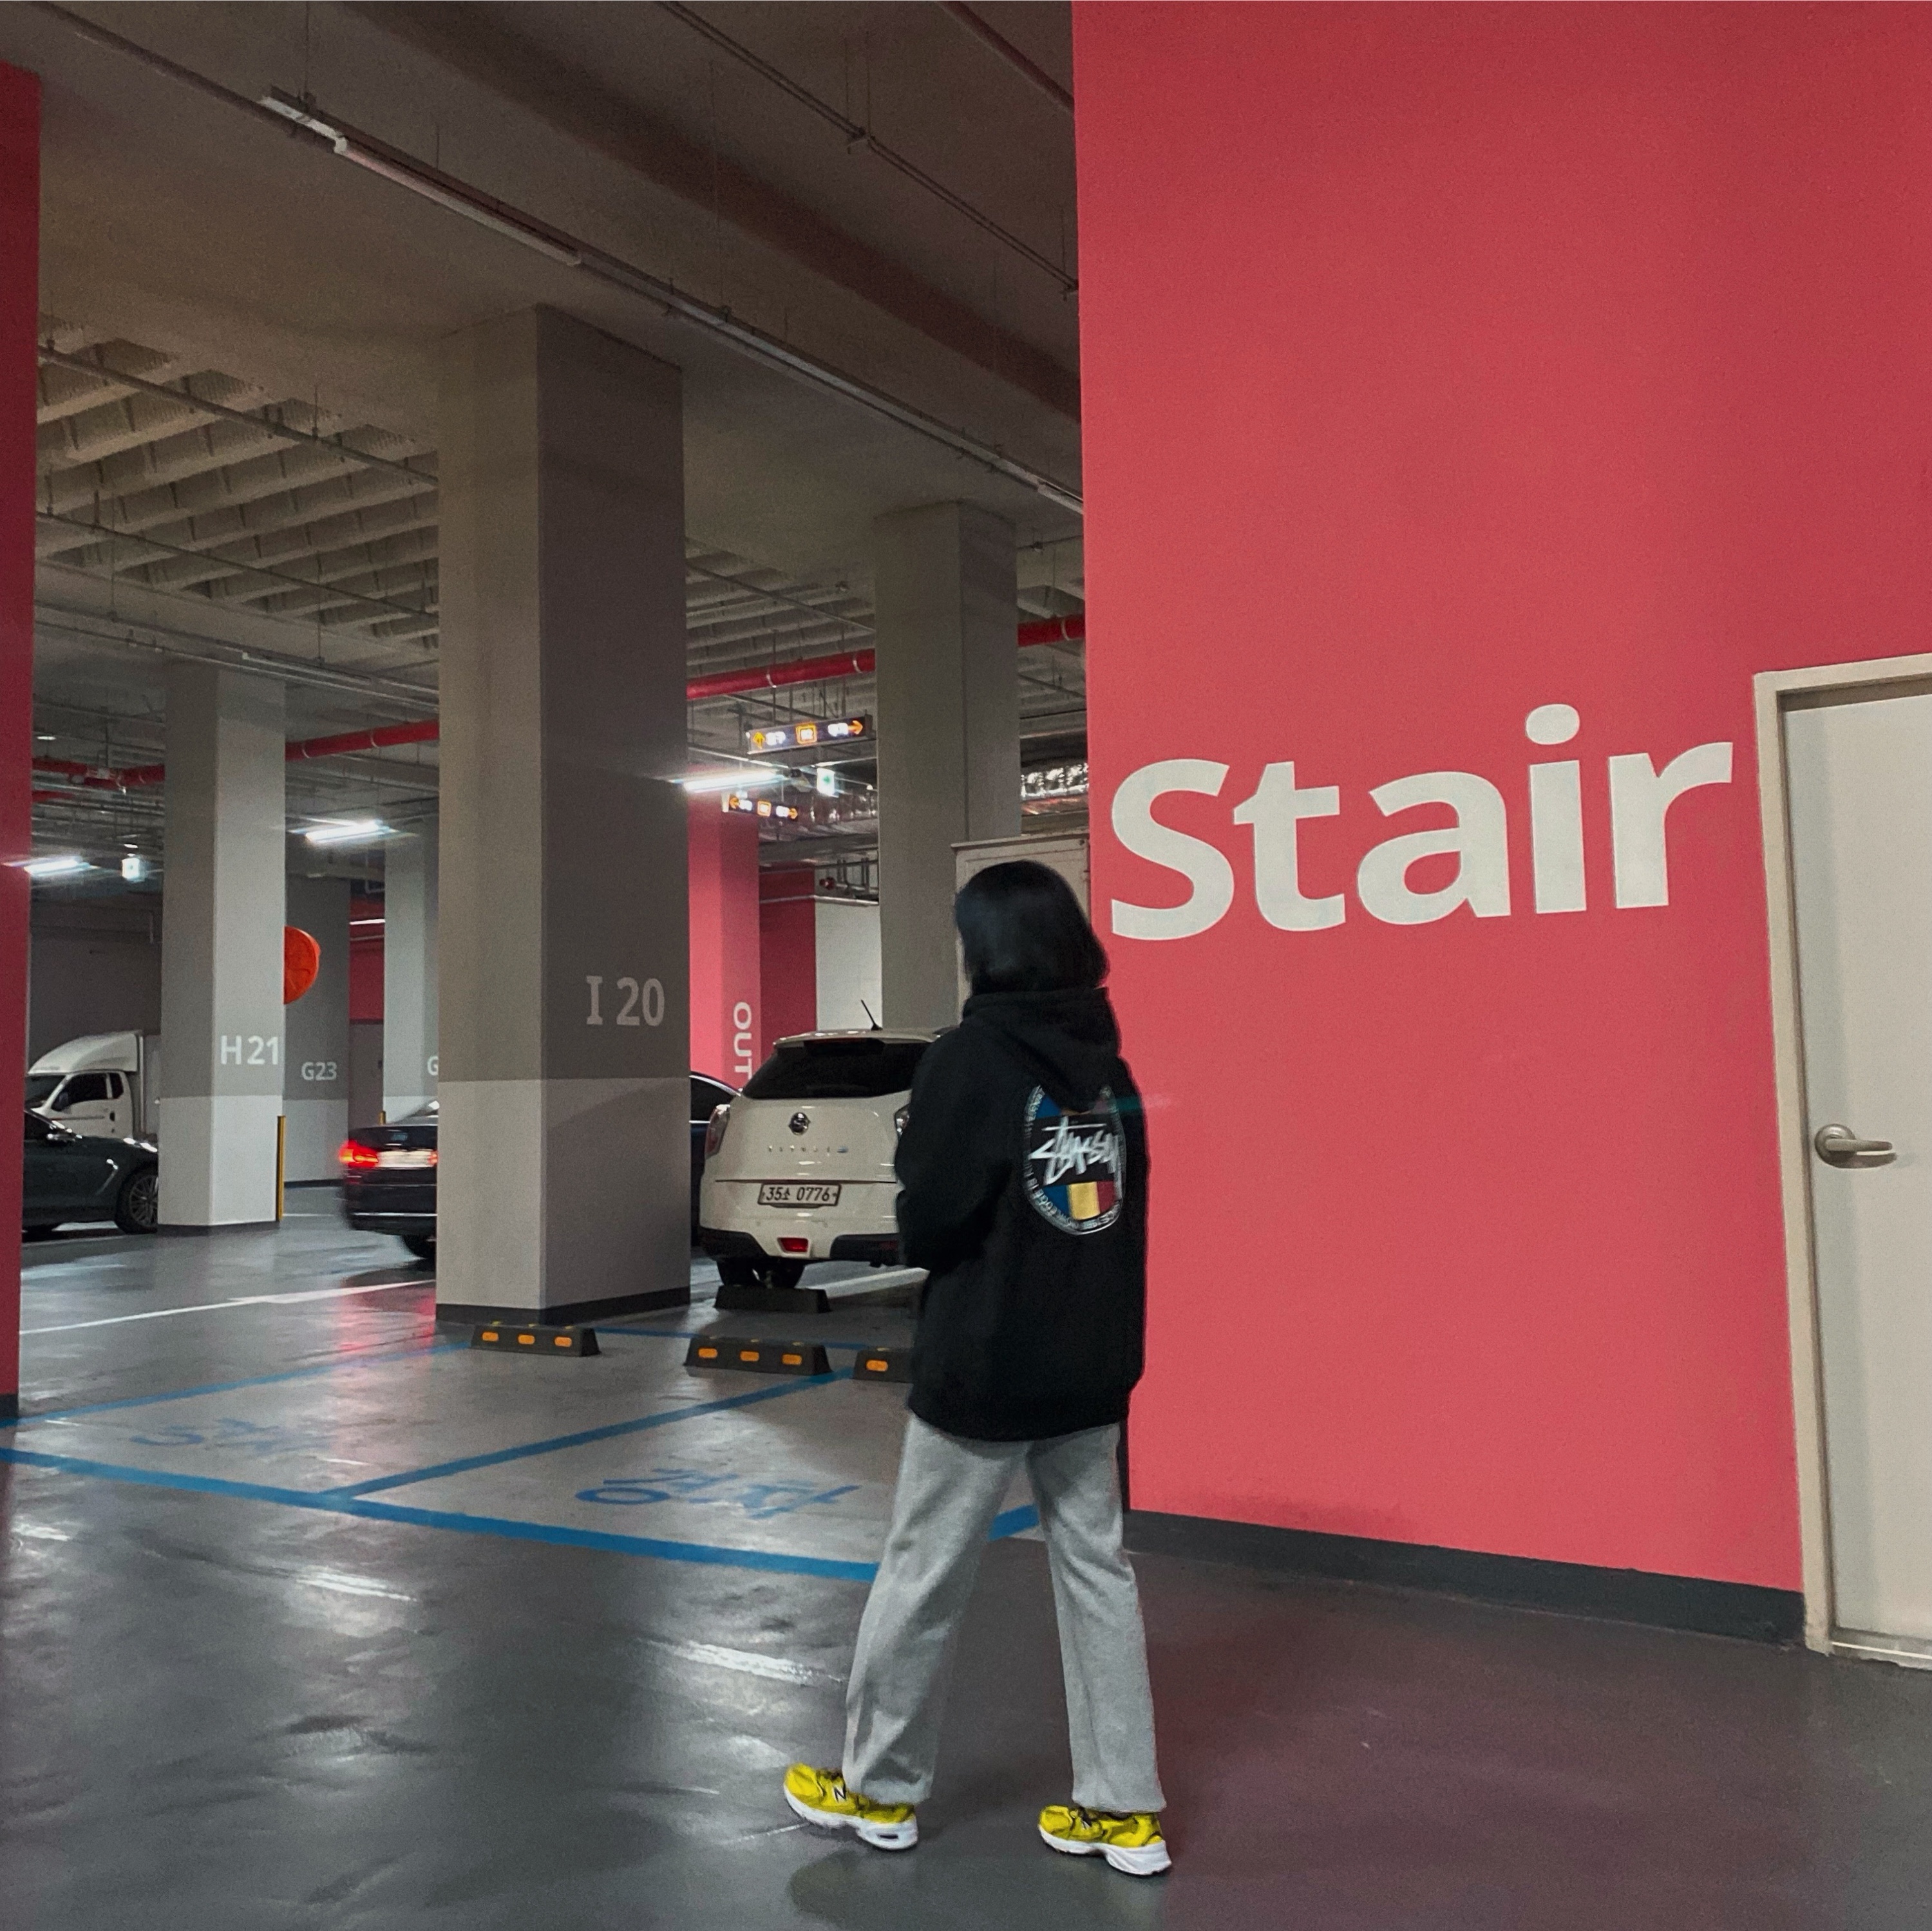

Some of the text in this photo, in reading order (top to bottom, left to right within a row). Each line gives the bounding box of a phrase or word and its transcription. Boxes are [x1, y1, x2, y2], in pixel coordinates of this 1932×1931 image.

[1112, 704, 1733, 940] Stair
[733, 1002, 752, 1080] OUT
[301, 1062, 337, 1080] G23
[797, 1187, 829, 1201] 0776
